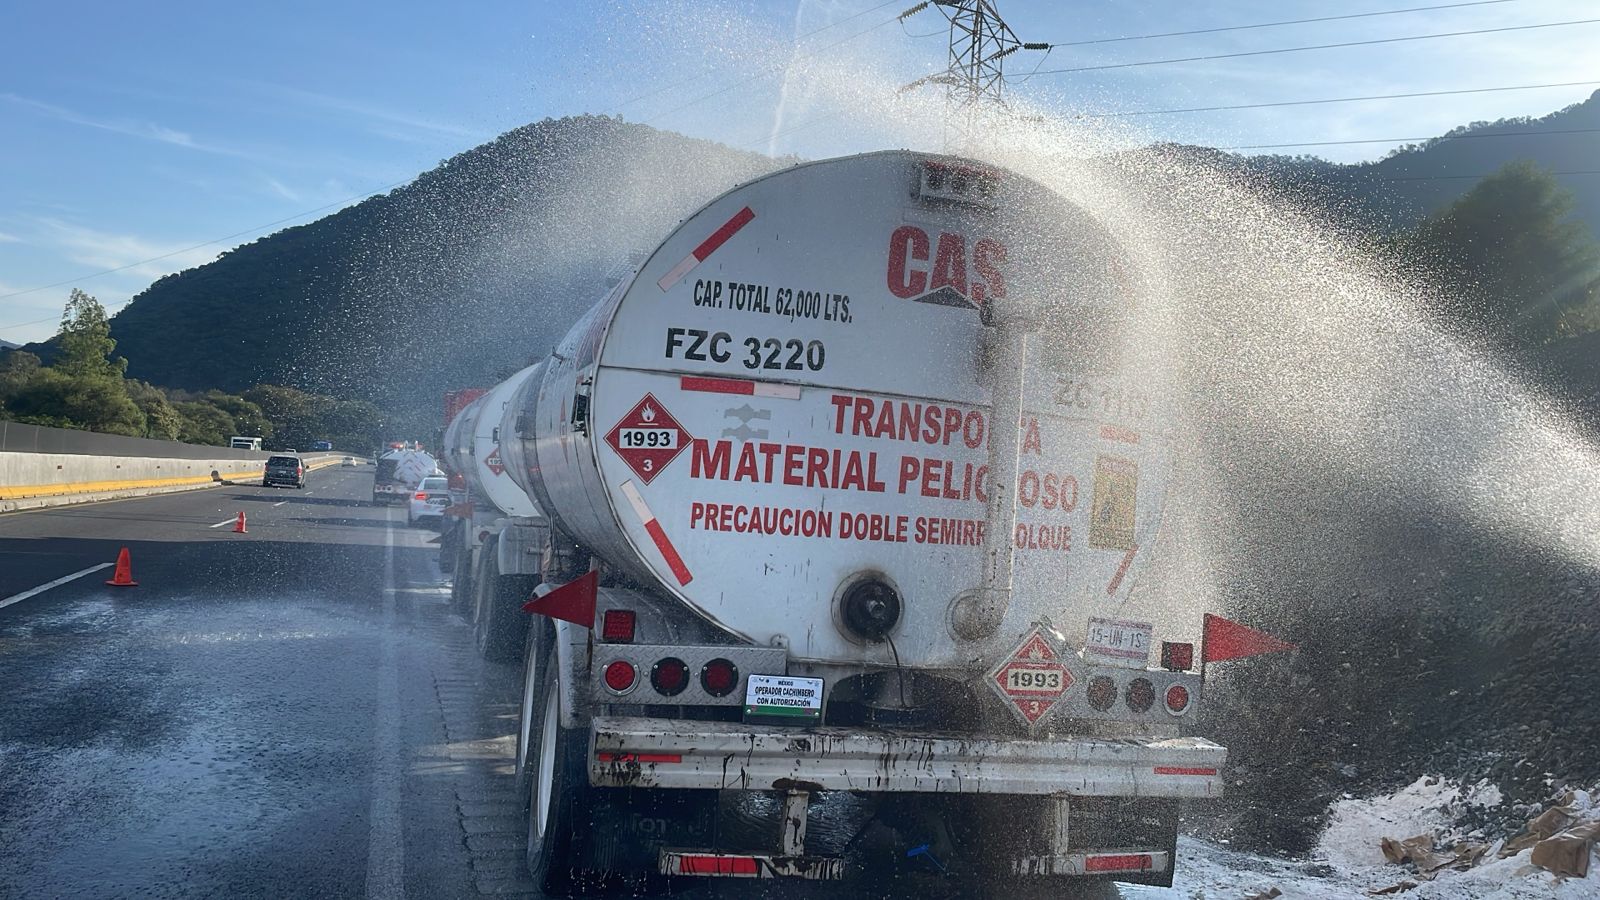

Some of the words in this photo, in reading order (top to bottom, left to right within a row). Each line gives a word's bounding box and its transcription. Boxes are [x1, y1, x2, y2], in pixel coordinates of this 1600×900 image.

[887, 225, 1007, 306] CAS
[693, 279, 724, 309] CAP.
[728, 282, 771, 316] TOTAL
[775, 287, 820, 323] 62,000
[823, 294, 853, 324] LTS.
[665, 328, 732, 363] FZC
[743, 337, 826, 371] 3220
[622, 430, 672, 448] 1993
[831, 394, 1043, 456] TRANSPOA
[642, 458, 653, 472] 3
[690, 439, 885, 493] MATERIAL
[898, 455, 1079, 513] PELIGOSO
[690, 501, 837, 540] PRECAUCION
[839, 511, 910, 543] DOBLE
[914, 516, 1072, 552] SEMIRROLQUE
[754, 686, 783, 696] OPERADOR
[782, 688, 815, 698] CACHIMBERO
[1010, 671, 1059, 689] 1993
[756, 697, 769, 705] CON
[769, 697, 811, 707] AUTORIZACIÓN
[1029, 701, 1040, 714] 3
